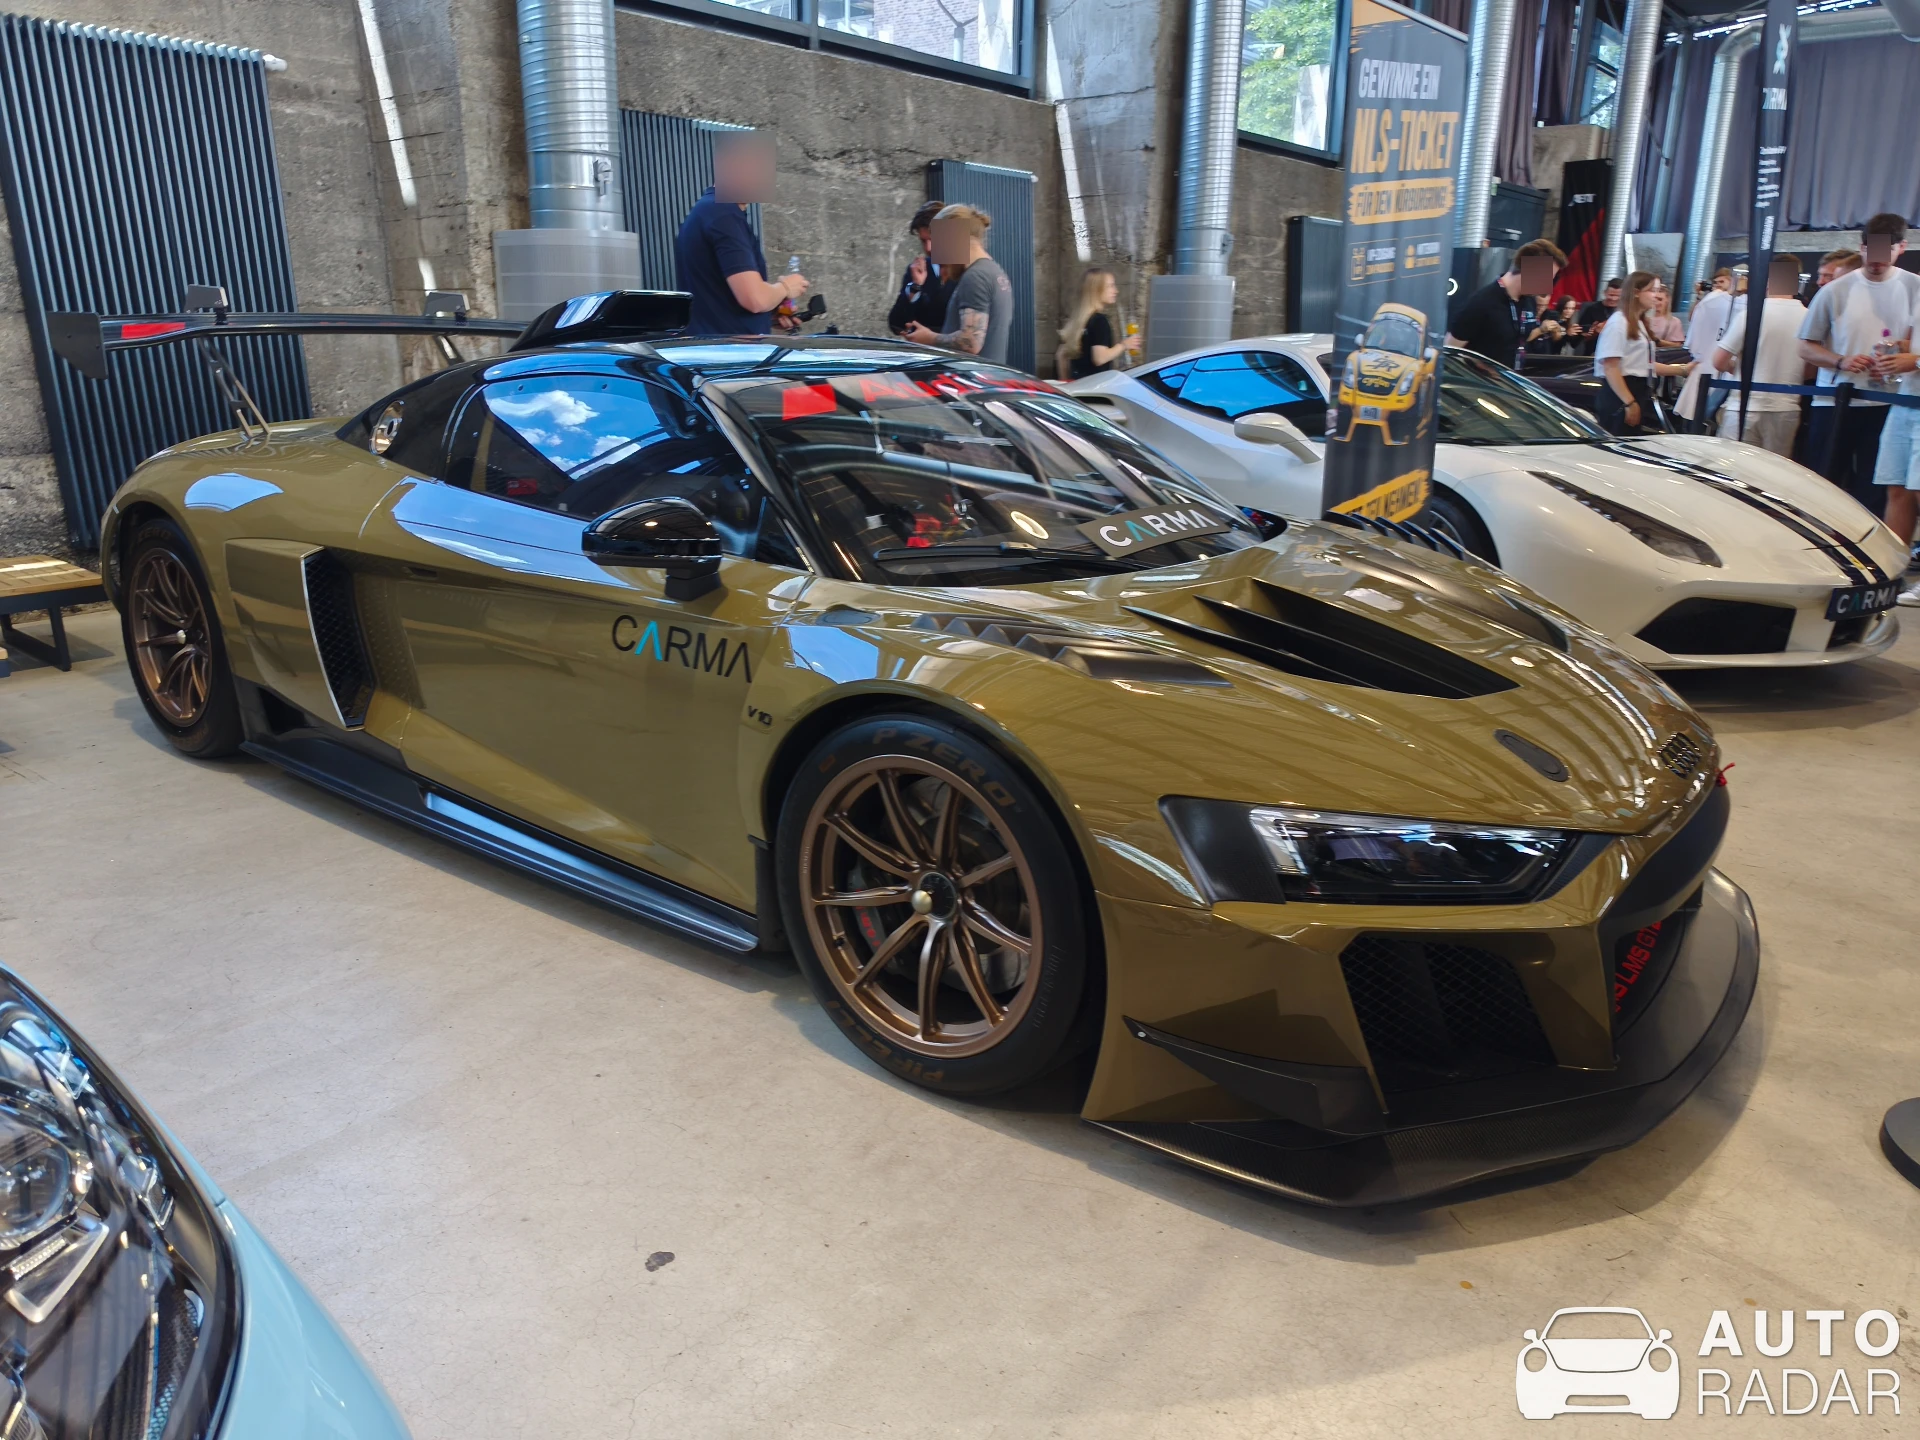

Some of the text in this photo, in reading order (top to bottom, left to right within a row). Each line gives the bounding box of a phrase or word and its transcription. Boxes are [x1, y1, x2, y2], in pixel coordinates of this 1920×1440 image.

[1359, 58, 1441, 100] GEWINNE EIN
[1350, 108, 1459, 173] NLS-TICKET
[858, 373, 981, 402] Audi
[1100, 509, 1219, 547] CARMA
[612, 615, 752, 683] CARMA
[748, 705, 773, 726] V10
[904, 732, 1017, 807] ZERO
[1614, 945, 1652, 985] LMS
